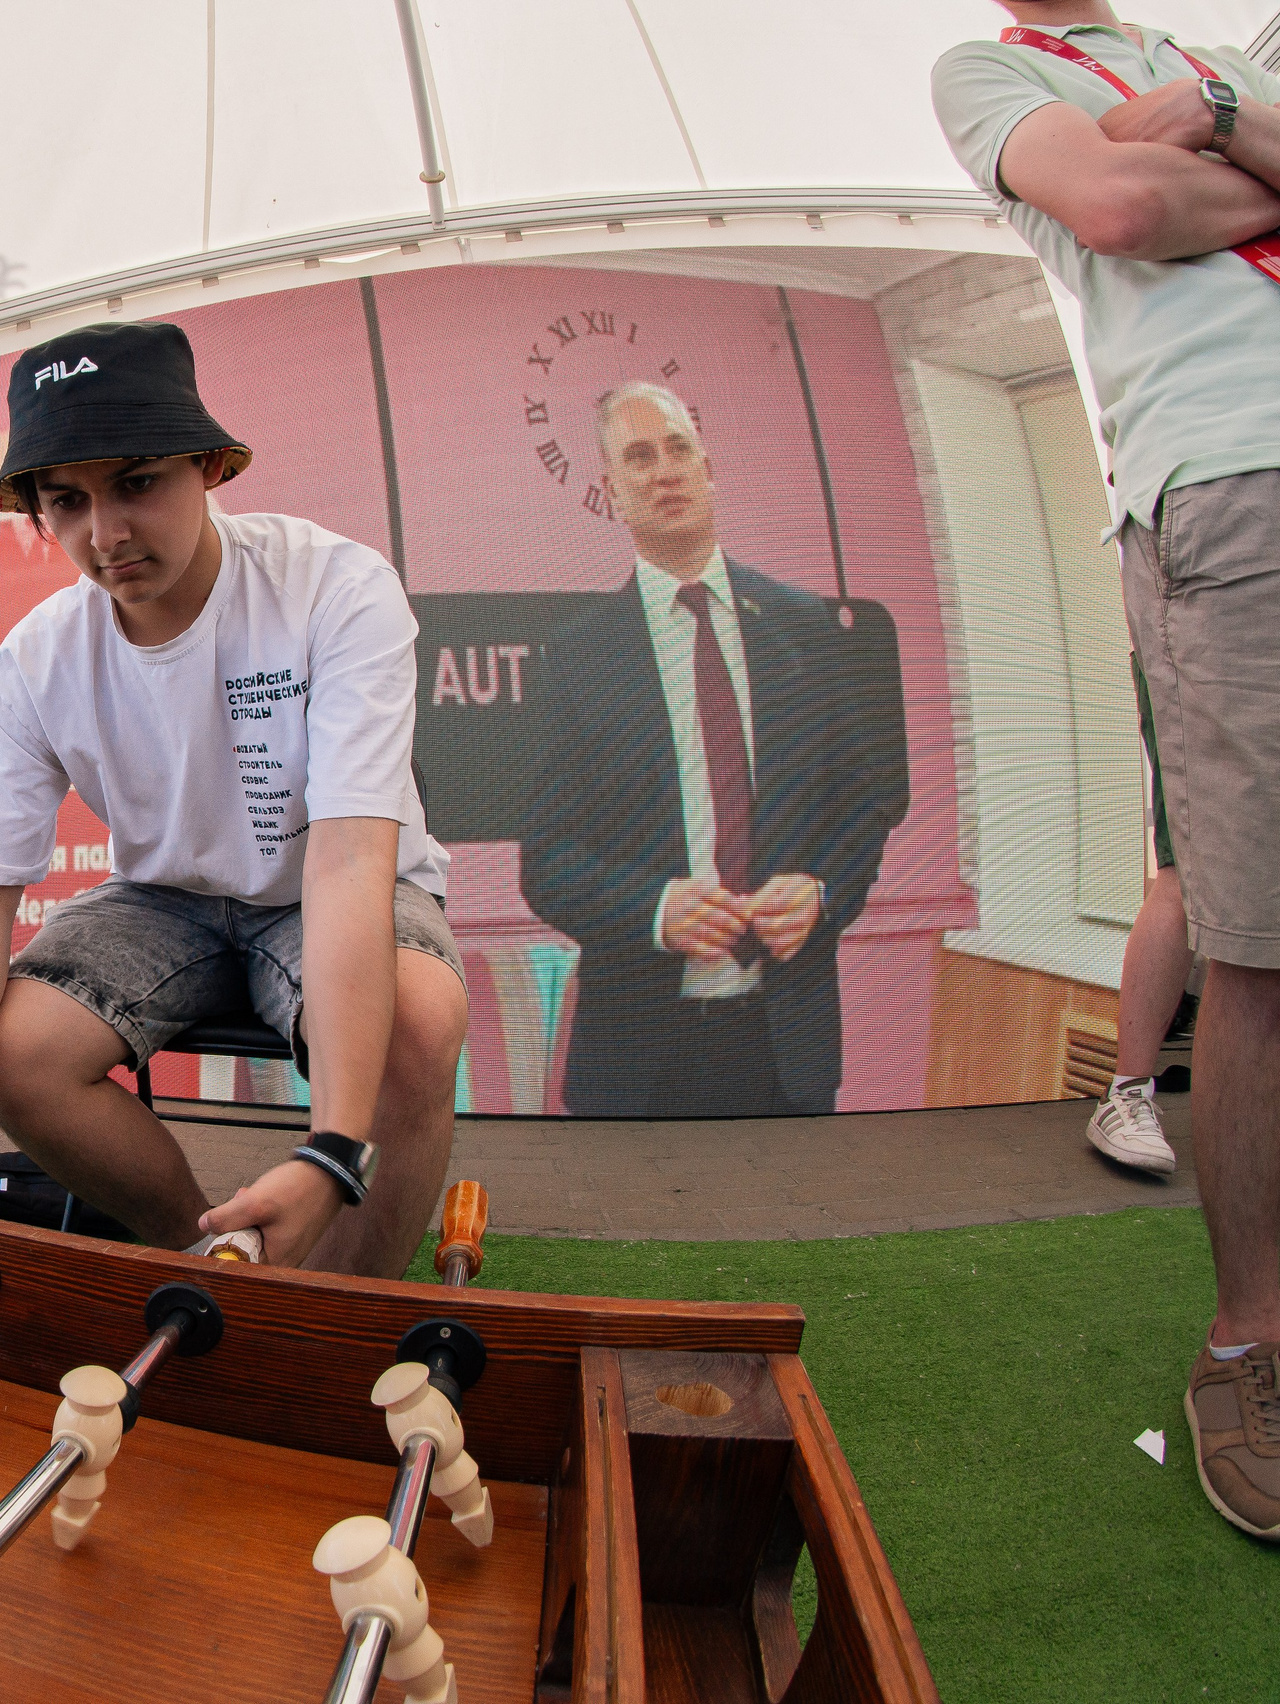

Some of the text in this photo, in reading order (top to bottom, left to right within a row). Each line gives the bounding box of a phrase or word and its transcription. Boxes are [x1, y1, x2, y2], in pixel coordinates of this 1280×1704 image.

[35, 357, 98, 390] FILA
[432, 645, 546, 705] AUT
[238, 761, 283, 769] СТРОИТЕЛЬ
[241, 776, 269, 785] СЕРВИС
[245, 789, 293, 800] ПРОВОДНИК
[248, 806, 284, 815] СЕЛЬХОЗ
[252, 820, 279, 829] МЕДИК
[255, 822, 310, 843] ПРОФИЛЬНЫ
[260, 847, 277, 857] ТОП
